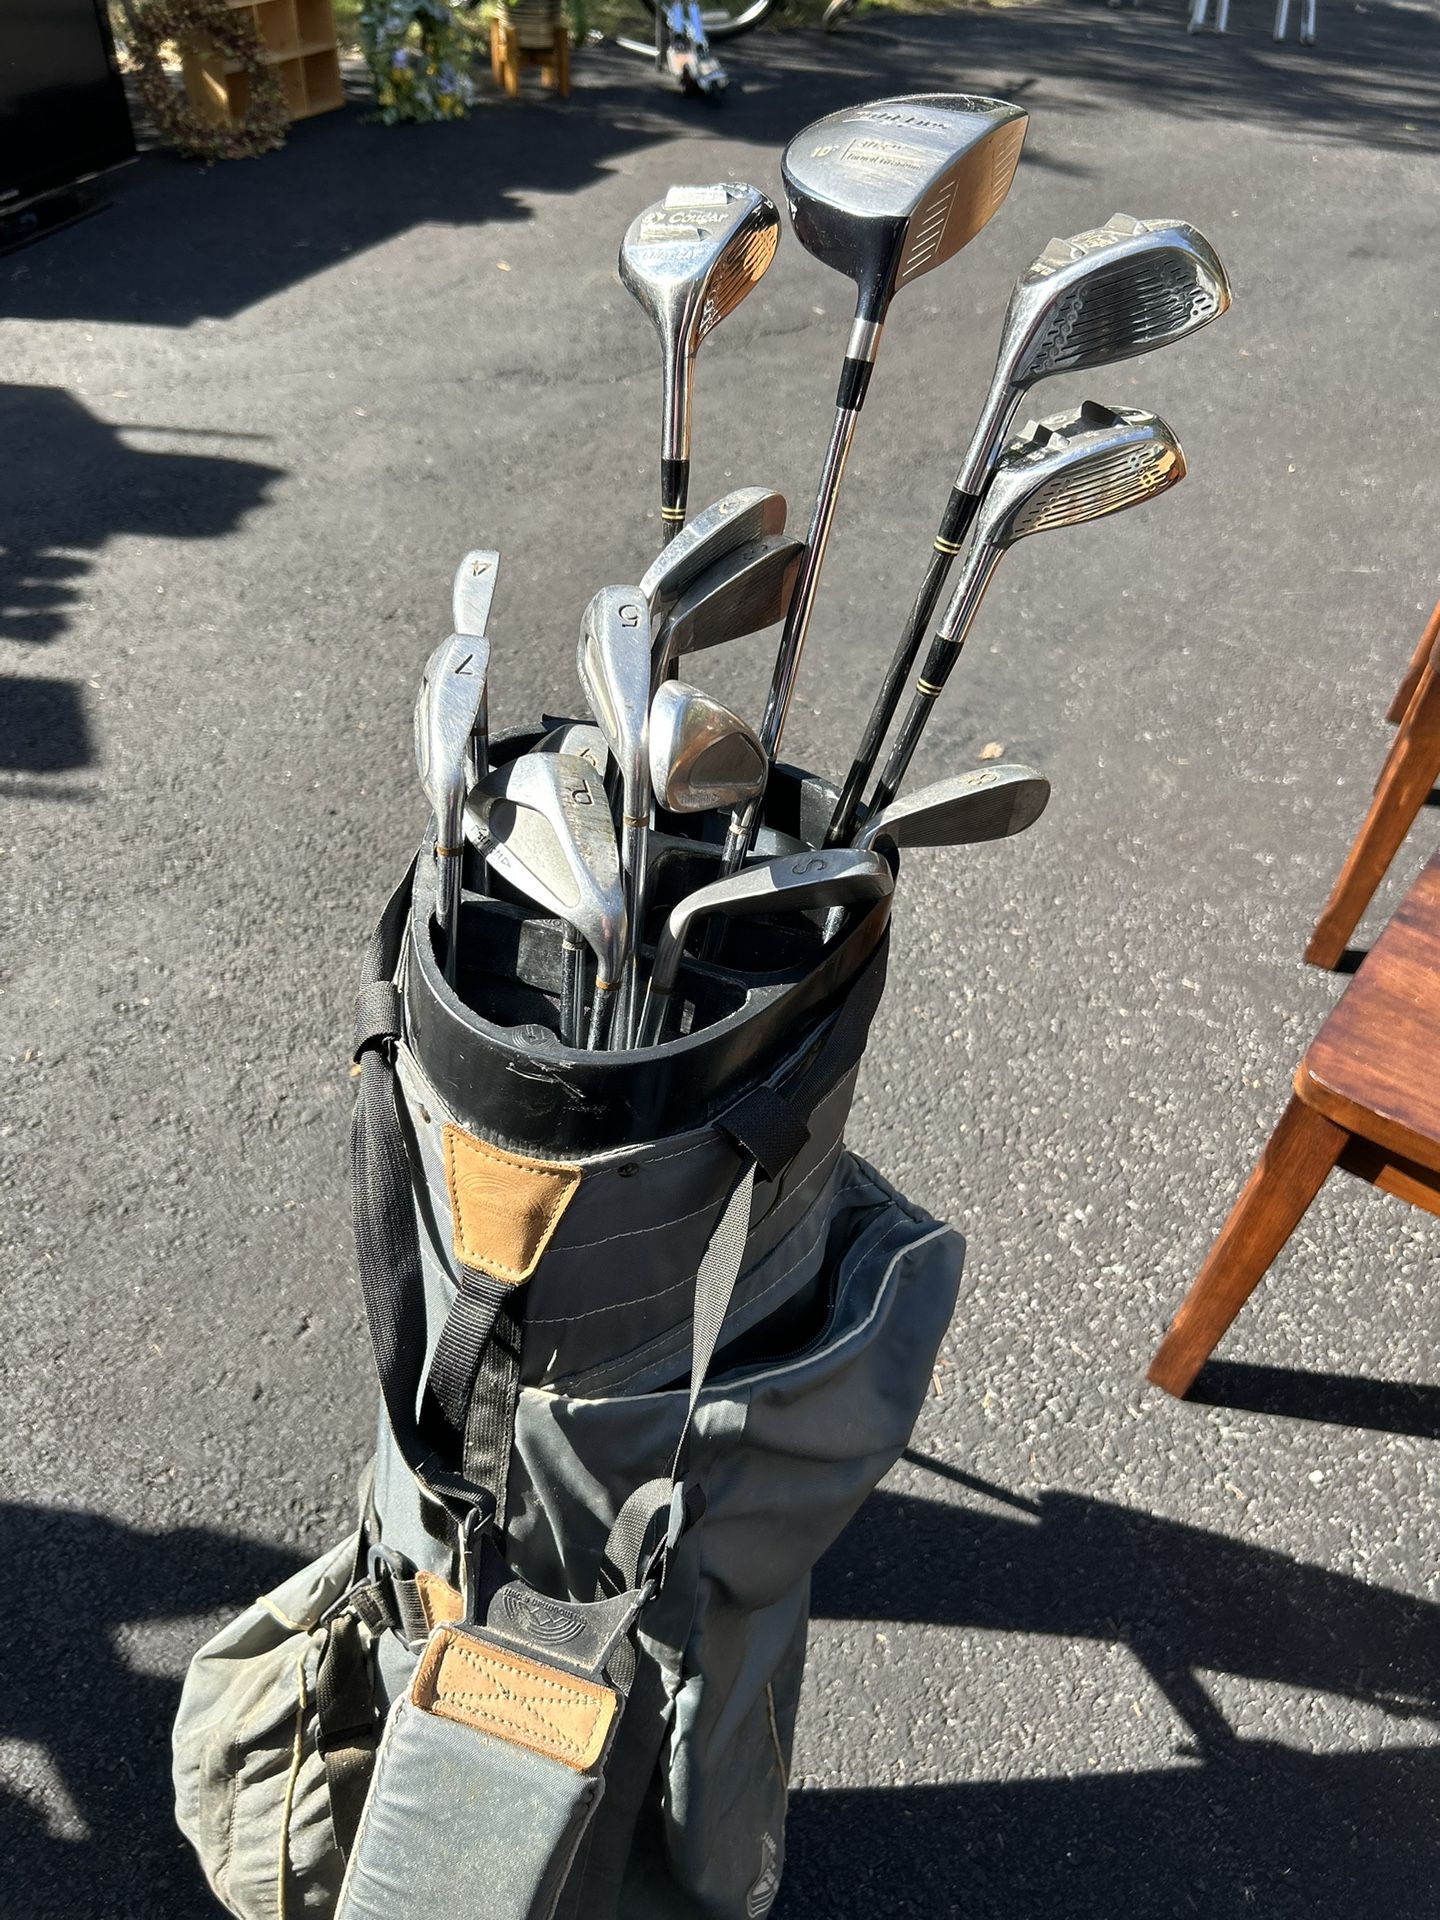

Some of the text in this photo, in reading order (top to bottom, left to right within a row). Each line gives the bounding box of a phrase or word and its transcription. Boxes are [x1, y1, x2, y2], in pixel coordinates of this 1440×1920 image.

[668, 211, 729, 225] Cougar
[471, 560, 492, 577] 4
[618, 604, 639, 628] 5
[454, 653, 474, 675] 7
[571, 778, 594, 806] P
